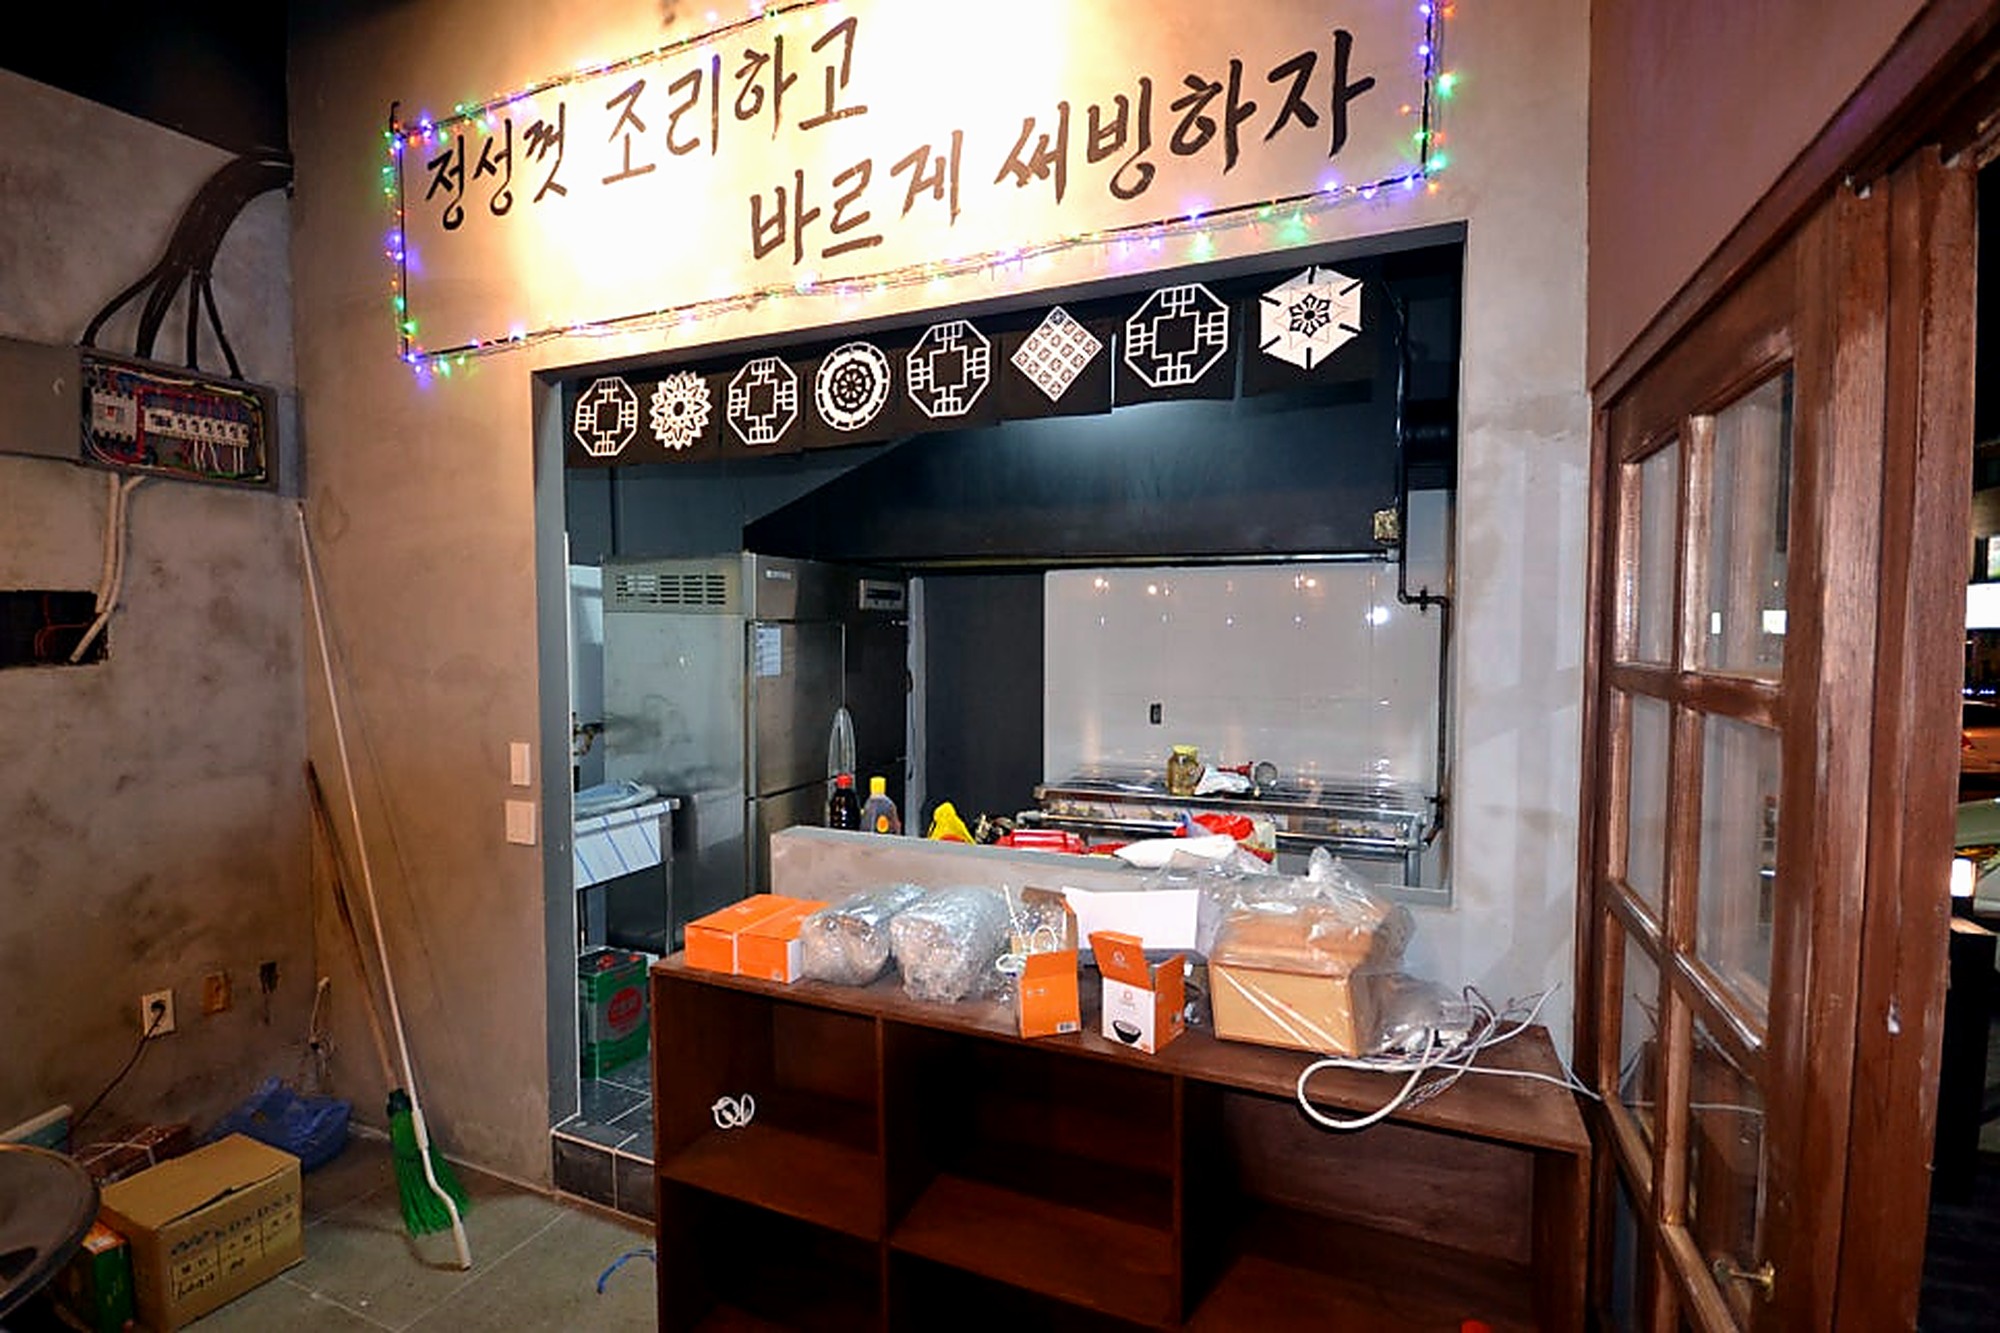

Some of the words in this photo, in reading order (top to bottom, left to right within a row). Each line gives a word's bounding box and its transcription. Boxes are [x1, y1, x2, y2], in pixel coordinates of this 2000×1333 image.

[602, 17, 868, 185] 조리하고
[750, 130, 964, 265] 바르게
[994, 30, 1375, 204] 써빙하자
